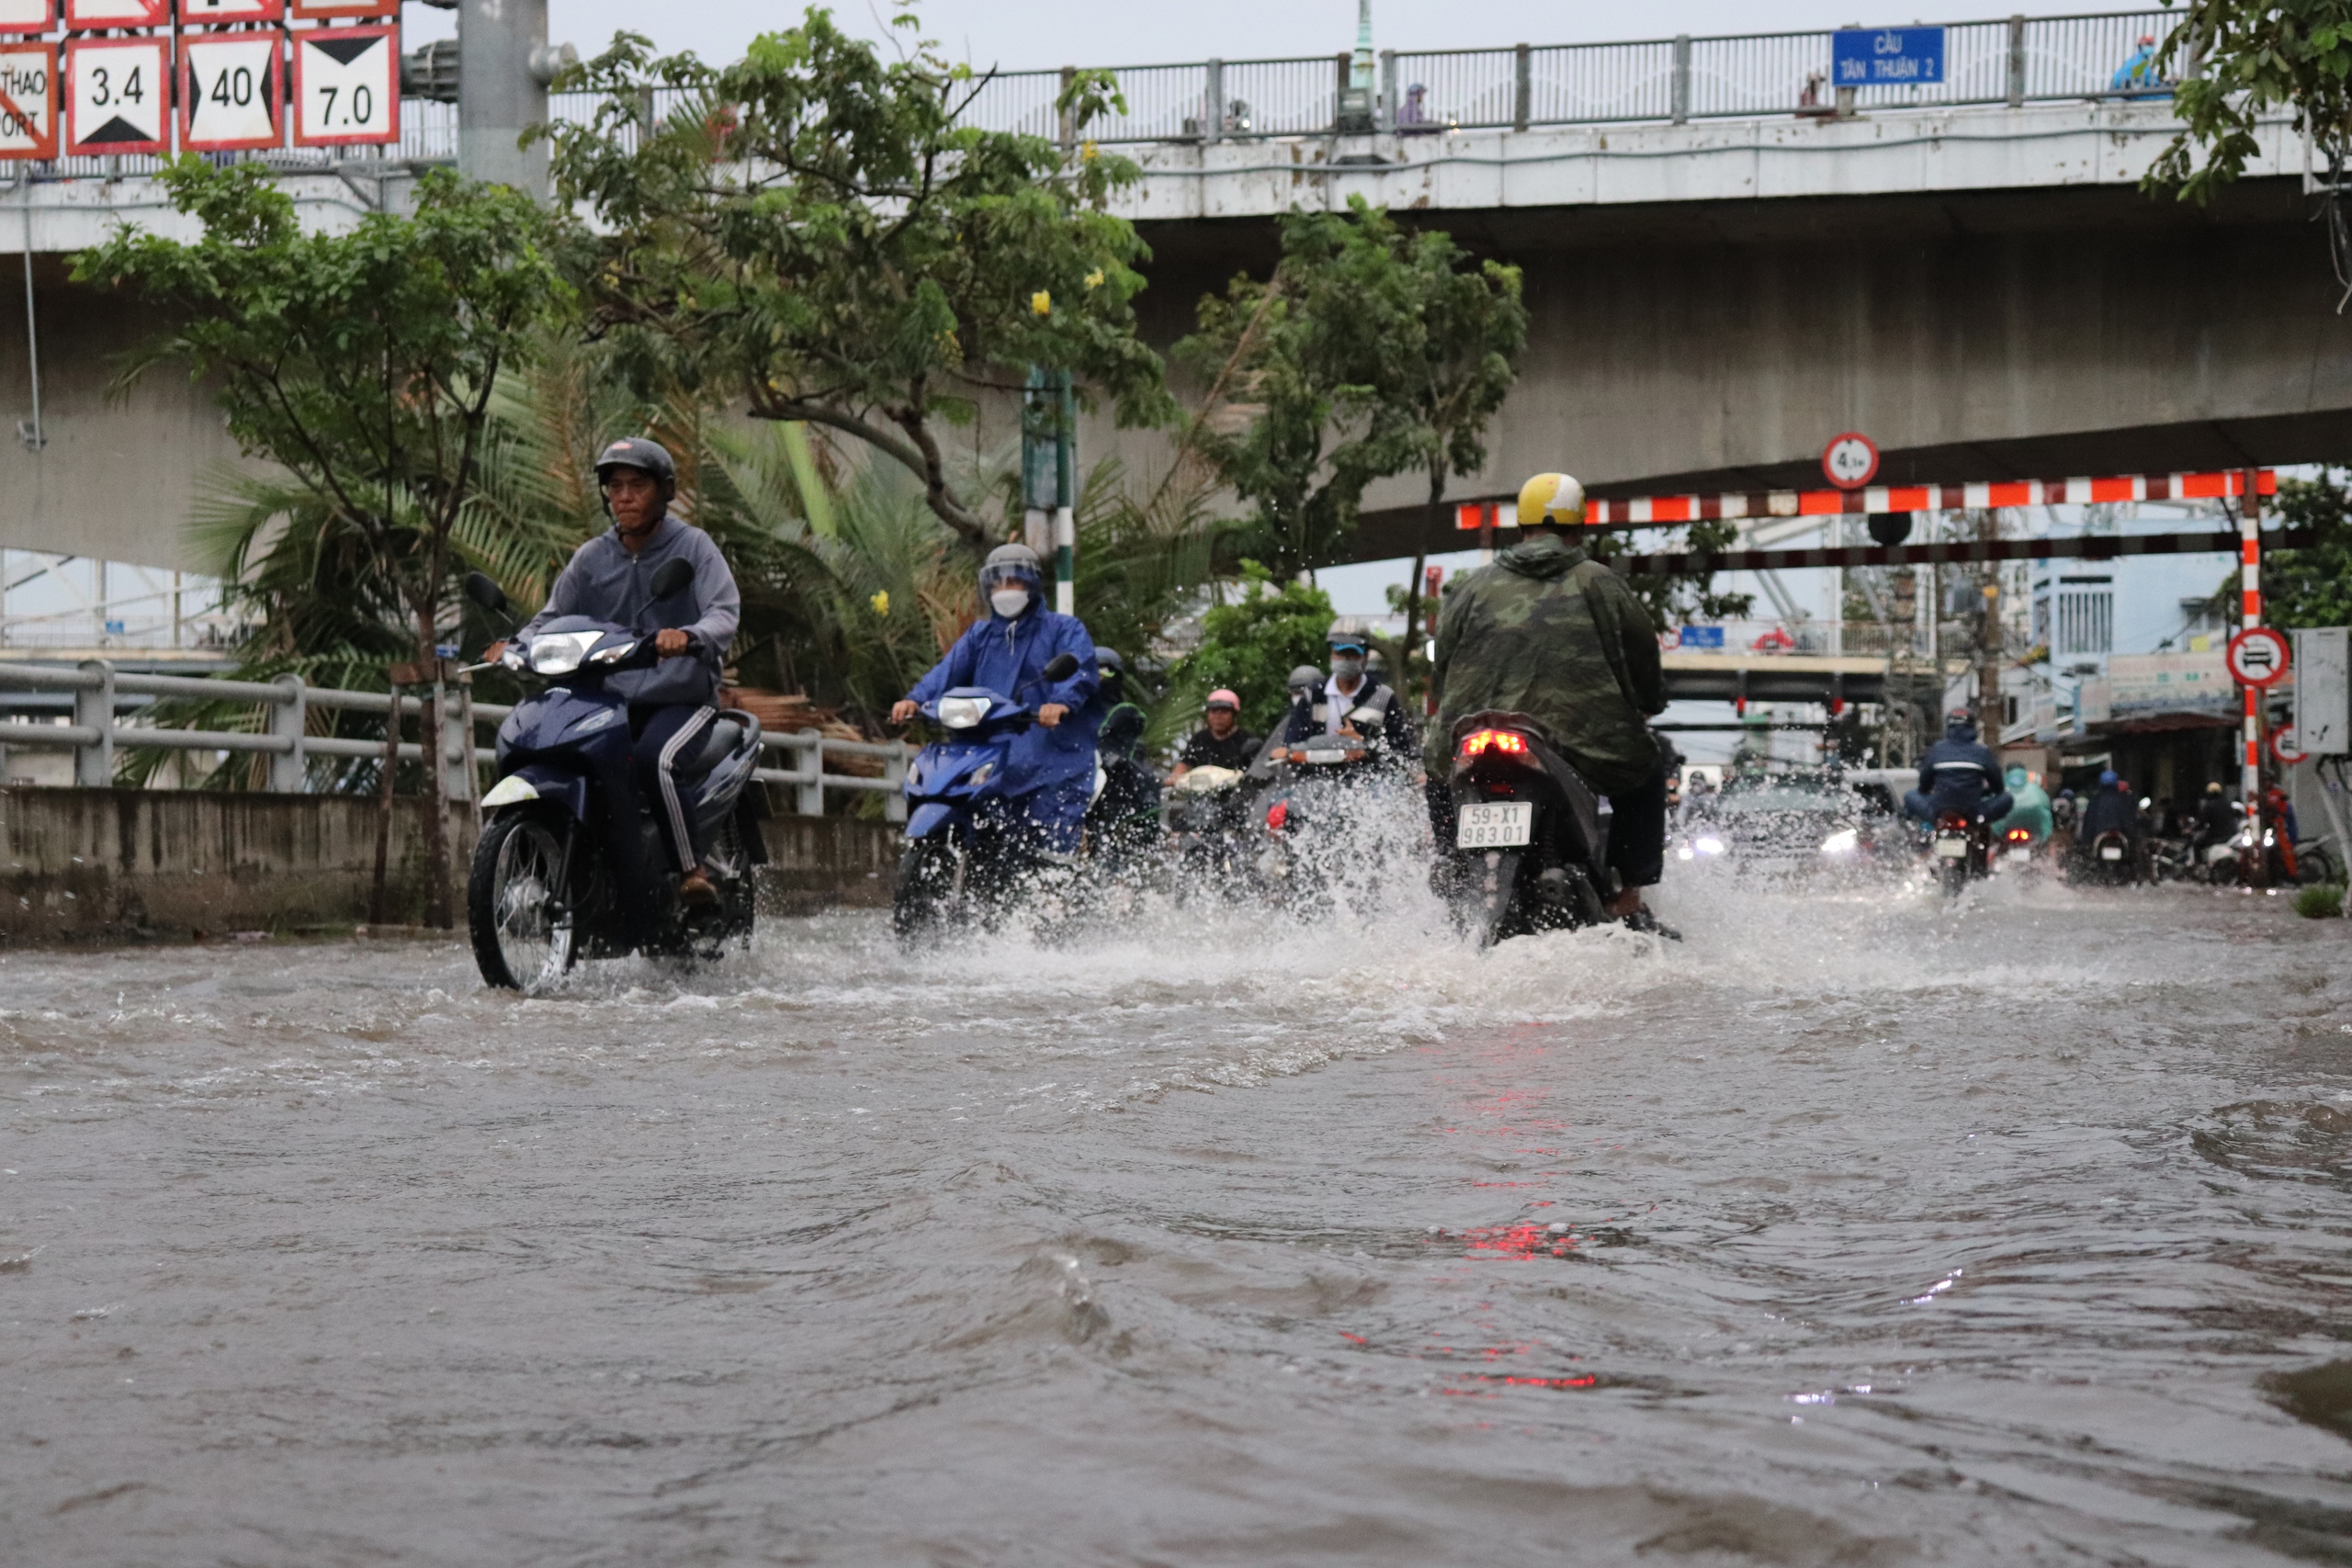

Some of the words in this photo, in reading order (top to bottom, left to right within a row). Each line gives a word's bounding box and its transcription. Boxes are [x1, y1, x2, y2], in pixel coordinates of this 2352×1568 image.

[1924, 57, 1935, 77] 2
[92, 65, 143, 106] 3.4
[211, 66, 252, 107] 40
[320, 85, 371, 126] 7.0
[0, 110, 39, 137] ORT
[1472, 807, 1519, 825] 59-X1
[1464, 826, 1523, 844] 983.01
